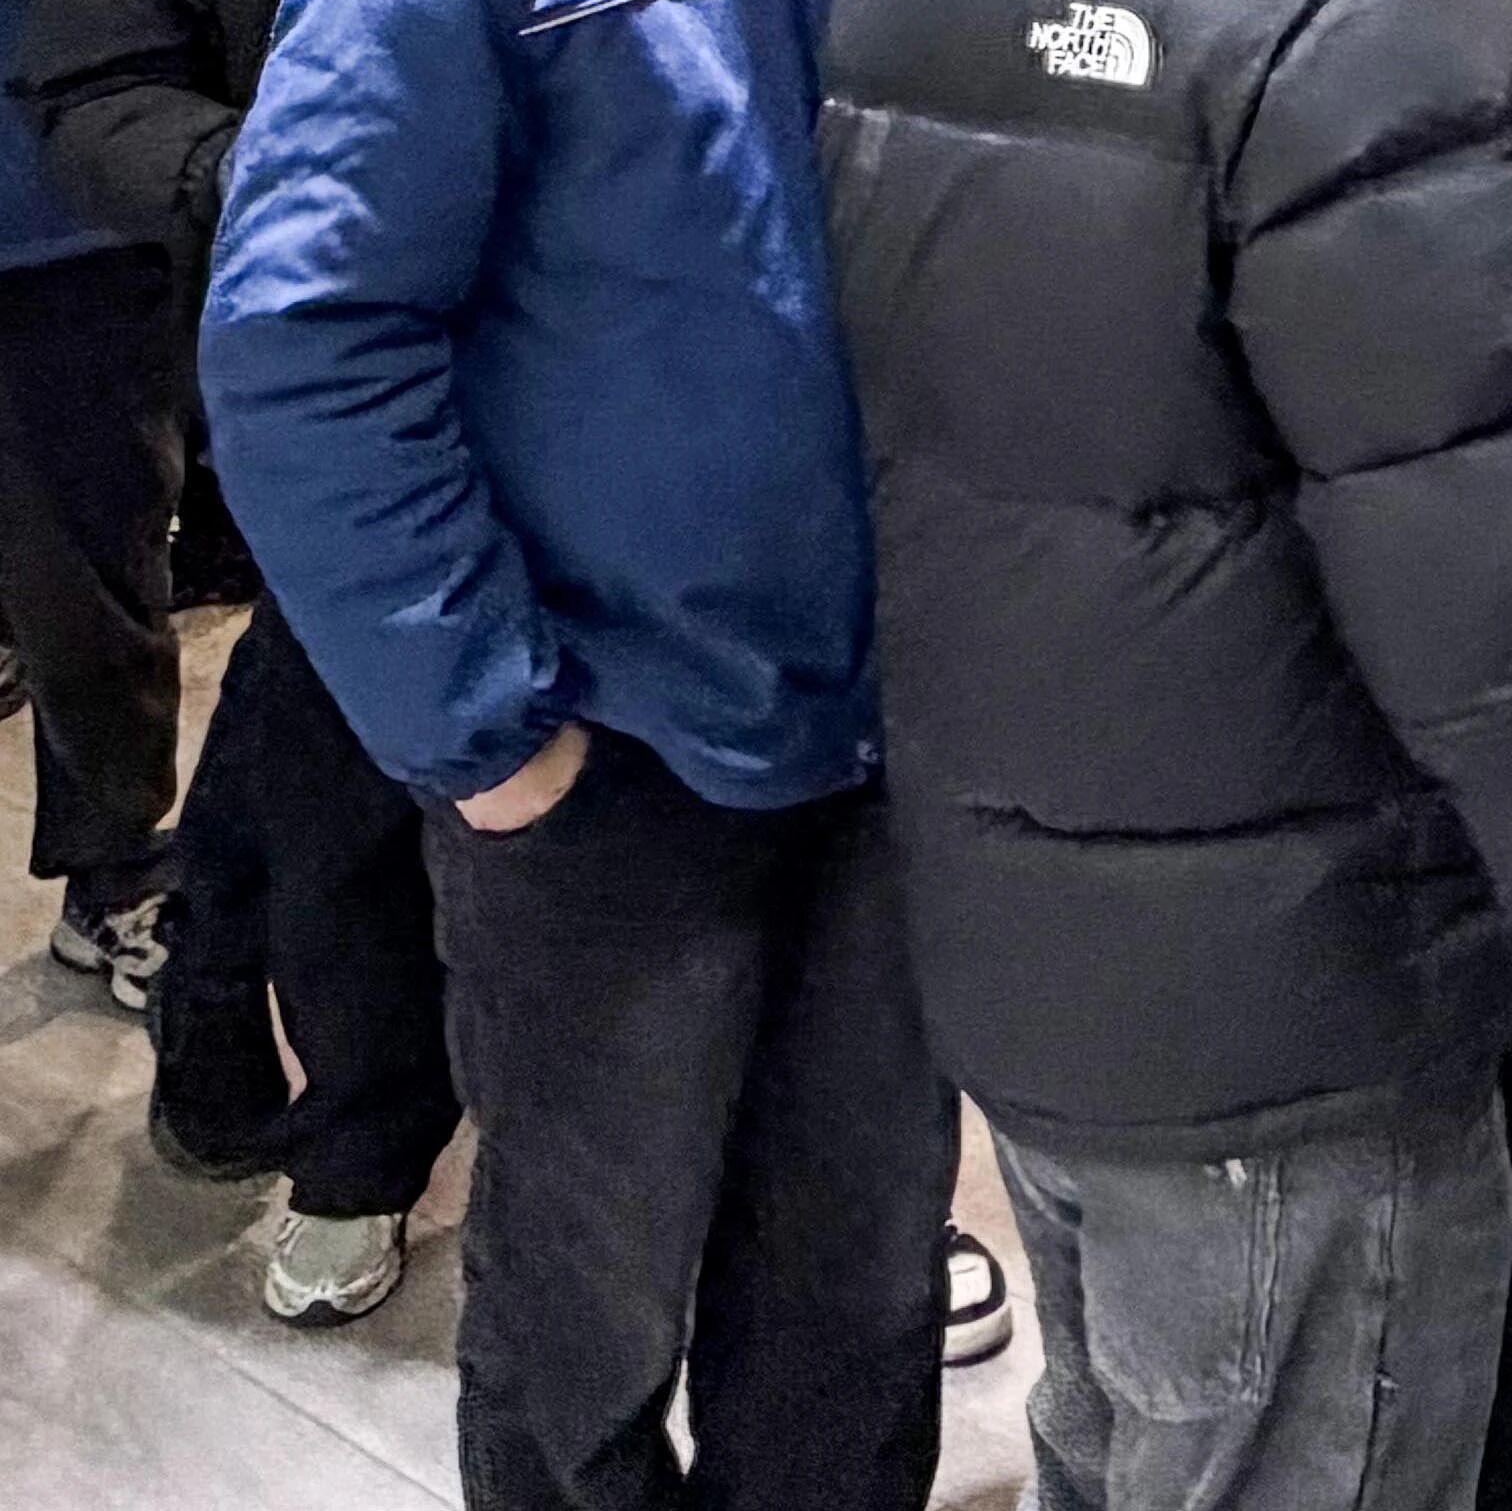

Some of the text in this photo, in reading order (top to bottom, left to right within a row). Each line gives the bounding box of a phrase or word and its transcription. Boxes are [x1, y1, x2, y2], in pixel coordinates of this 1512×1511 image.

[1068, 1, 1116, 30] THE
[1028, 21, 1110, 55] NORTH
[1046, 49, 1106, 78] FACE
